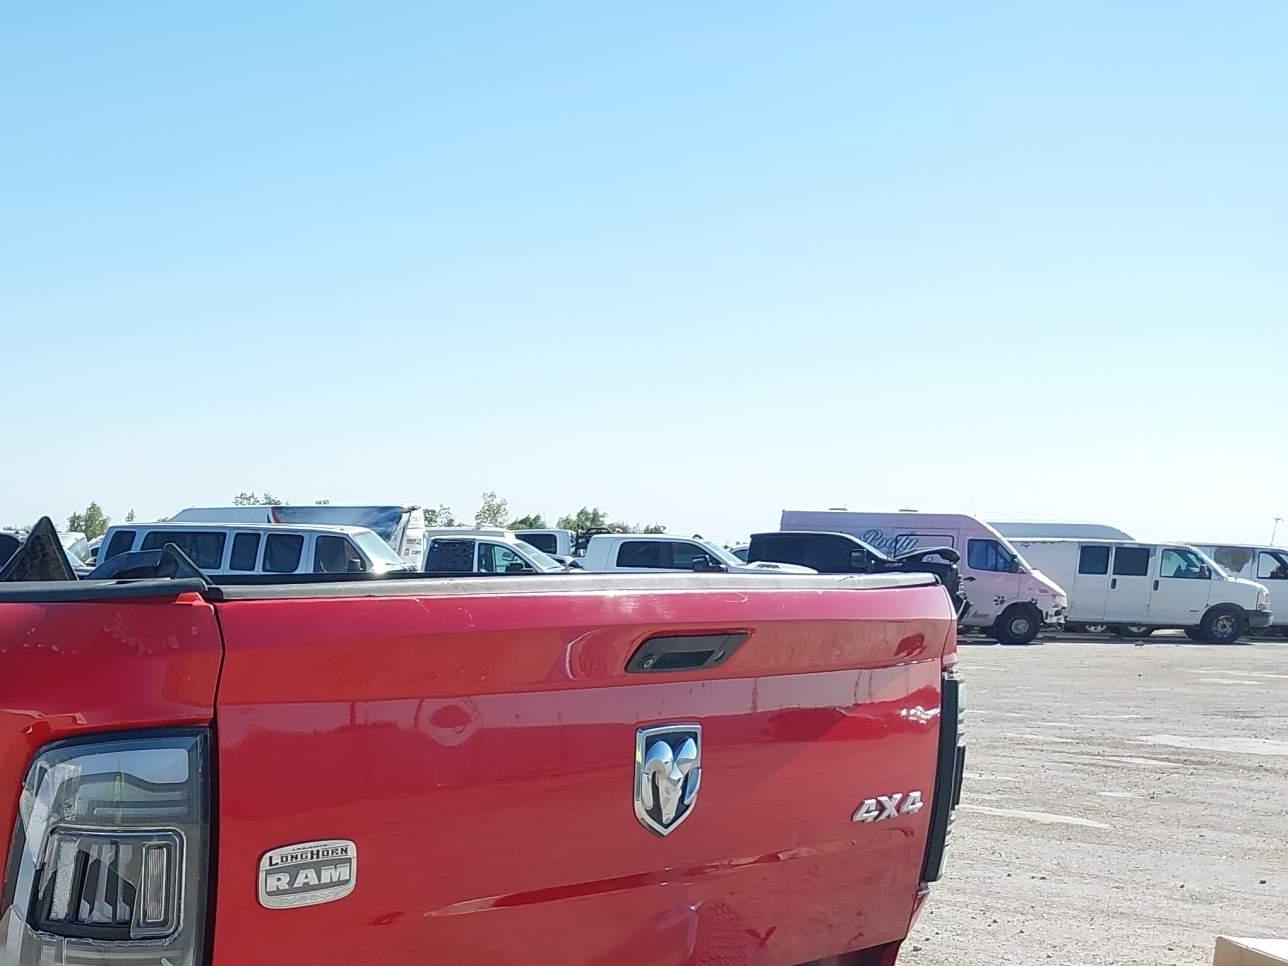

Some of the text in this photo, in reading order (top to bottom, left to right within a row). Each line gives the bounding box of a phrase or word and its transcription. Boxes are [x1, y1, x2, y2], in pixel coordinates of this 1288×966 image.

[852, 790, 924, 823] 4X4
[268, 846, 350, 867] LONGHORN
[266, 863, 350, 892] RAM
